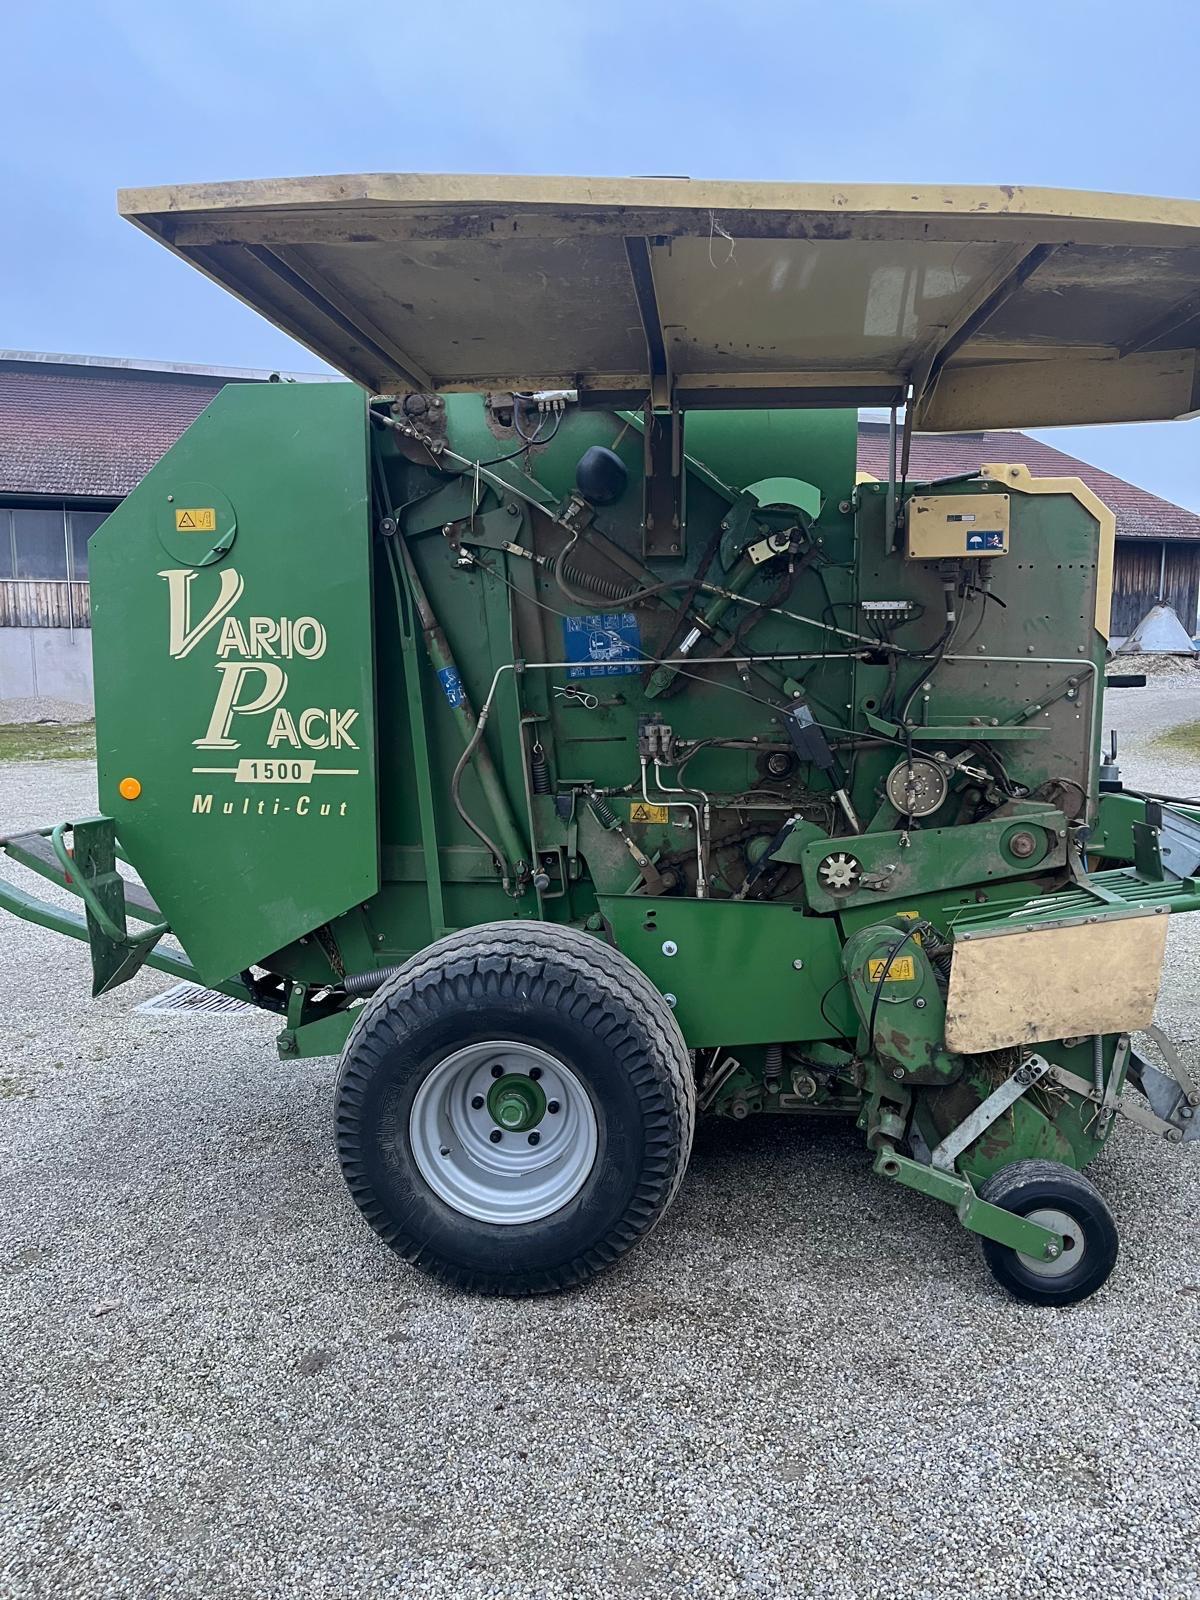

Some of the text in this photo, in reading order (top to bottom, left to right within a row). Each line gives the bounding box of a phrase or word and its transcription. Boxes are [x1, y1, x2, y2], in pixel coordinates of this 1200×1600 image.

[157, 567, 327, 660] VARIO
[192, 662, 360, 750] PACK
[250, 762, 302, 780] 1500
[192, 794, 347, 816] Multi-Cut
